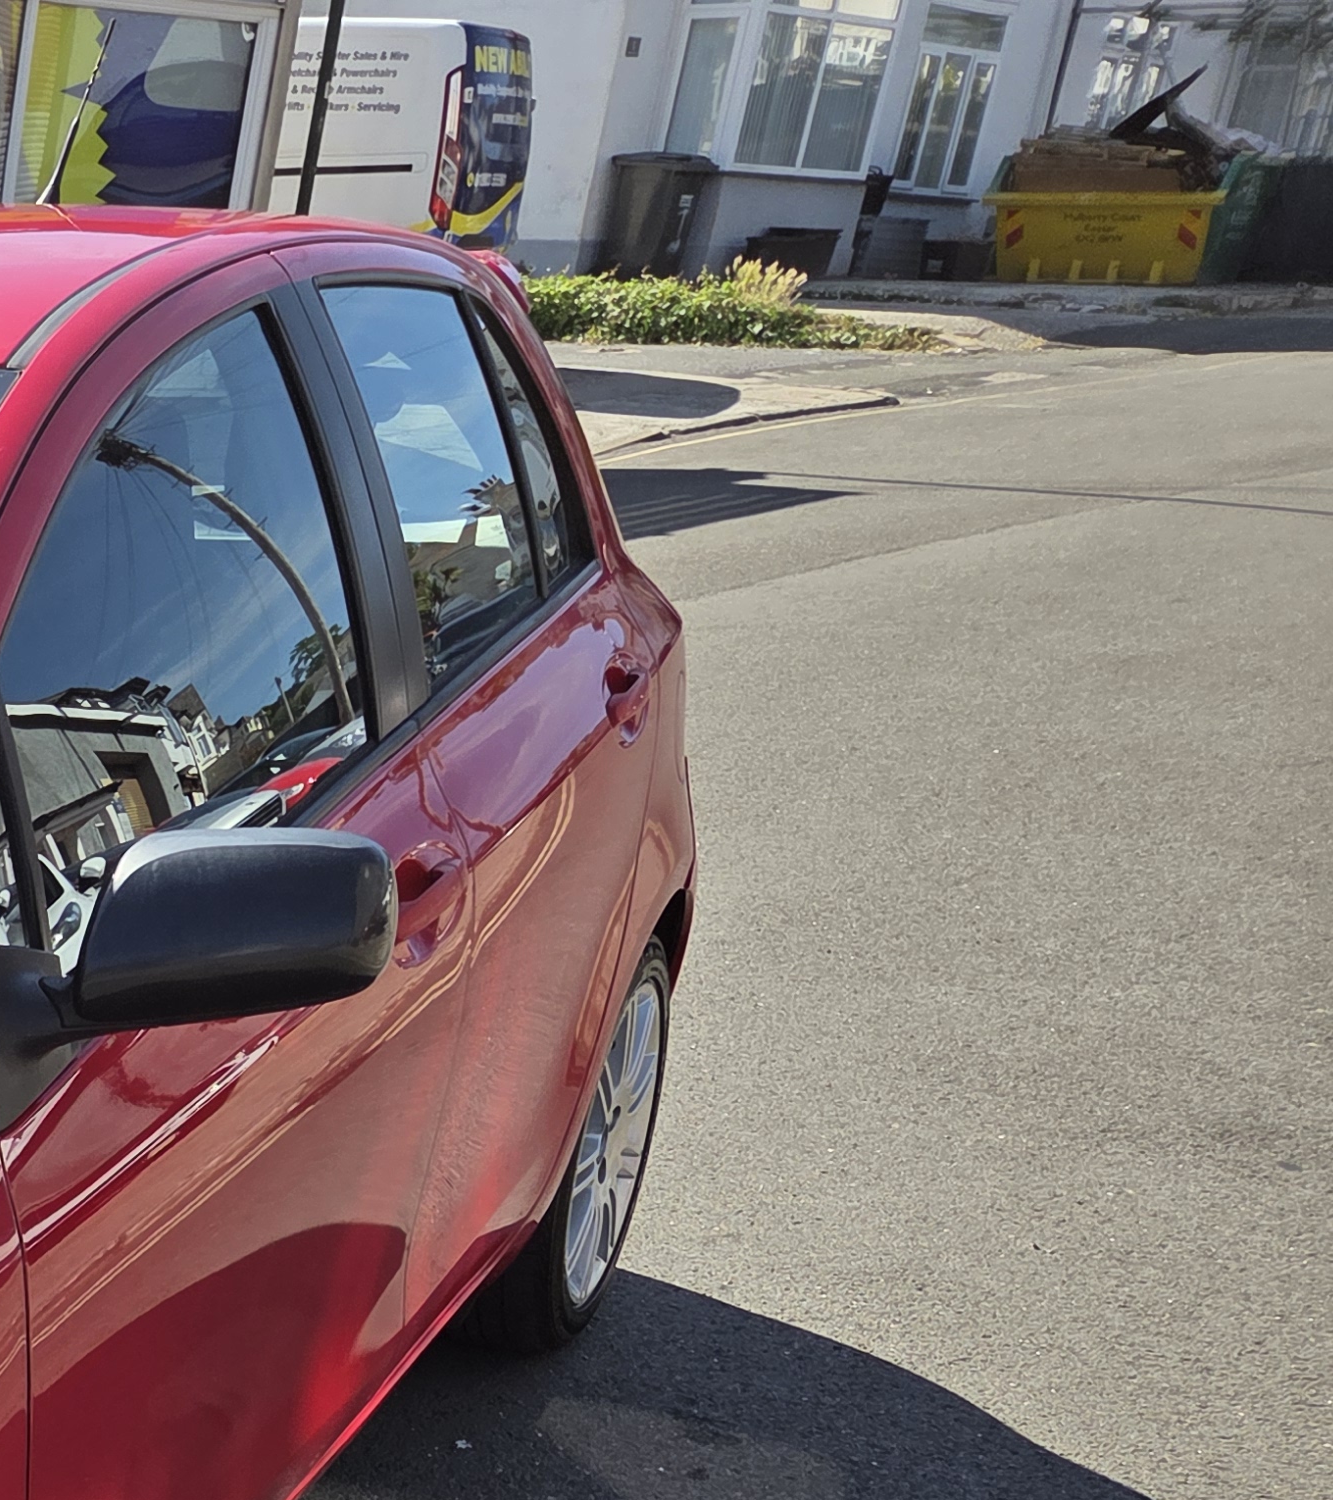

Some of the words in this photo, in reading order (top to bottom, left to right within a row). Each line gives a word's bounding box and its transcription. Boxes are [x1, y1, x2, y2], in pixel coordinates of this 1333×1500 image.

[353, 51, 378, 61] Sales
[379, 51, 388, 61] &
[389, 51, 409, 61] Hire
[474, 45, 508, 74] NEW
[340, 68, 397, 78] Powerchairs
[336, 85, 384, 95] Armchairs
[356, 101, 401, 114] Servicing
